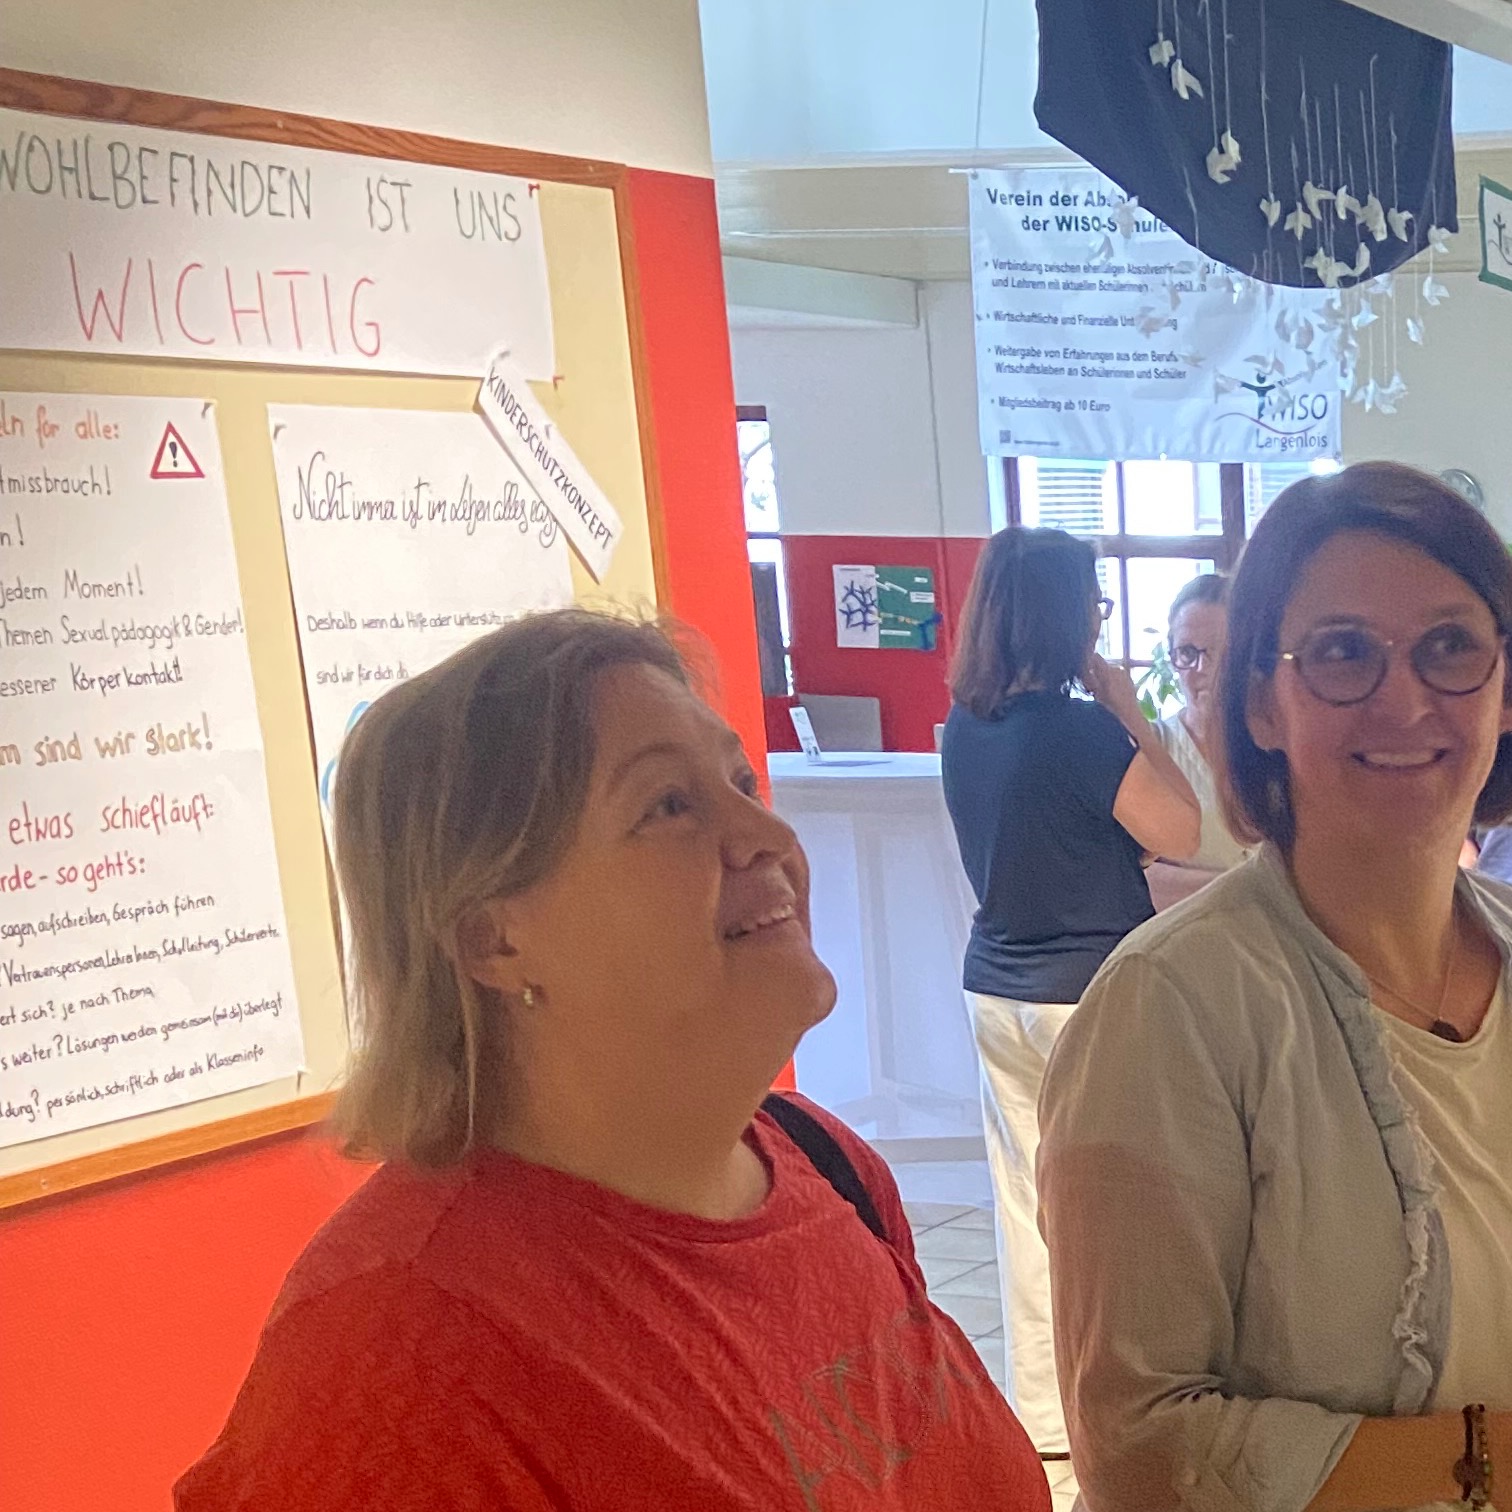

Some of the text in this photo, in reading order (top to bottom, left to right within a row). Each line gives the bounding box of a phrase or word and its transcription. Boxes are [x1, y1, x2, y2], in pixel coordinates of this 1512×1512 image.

[368, 177, 413, 232] IST
[455, 188, 522, 242] UNS
[986, 188, 1043, 206] Verein
[1050, 190, 1078, 206] der
[1021, 215, 1047, 232] der
[992, 277, 1008, 287] und
[993, 259, 1042, 274] Verbindung
[1045, 261, 1080, 272] zwischen
[70, 252, 381, 357] WICHTIG
[994, 311, 1058, 325] Wirtschaftliche
[1061, 315, 1076, 325] und
[1078, 315, 1118, 327] Finanzielle
[995, 345, 1041, 360] Weitergabe
[1044, 350, 1060, 359] von
[1063, 348, 1114, 363] Erfahrungen
[1116, 352, 1130, 361] aus
[1132, 351, 1149, 361] dem
[995, 362, 1186, 380] Wirtschaftsleben an Schülerinnen und Schüler
[999, 396, 1111, 412] Mitgliedsbeitrag ab 10 Euro
[74, 408, 119, 440] alle:
[1256, 428, 1328, 451] Langenlois
[486, 366, 613, 549] KINDERSCHUTZKONZEPT
[293, 451, 352, 521] Nicht
[402, 476, 430, 529] ist
[64, 563, 144, 599] Moment!
[35, 731, 82, 766] sind
[95, 730, 135, 758] wir
[9, 801, 73, 845] etwas
[56, 865, 78, 885] so
[83, 850, 145, 892] geht's:
[113, 899, 169, 923] Gespräch
[174, 895, 215, 917] führen
[21, 1000, 56, 1023] sich?
[80, 993, 110, 1010] nach
[112, 987, 155, 1003] Thema
[12, 1034, 63, 1067] weiter?
[66, 1034, 119, 1054] Lösungen
[164, 1065, 185, 1084] oder
[189, 1061, 203, 1077] als
[206, 1044, 264, 1072] Klasseninfo
